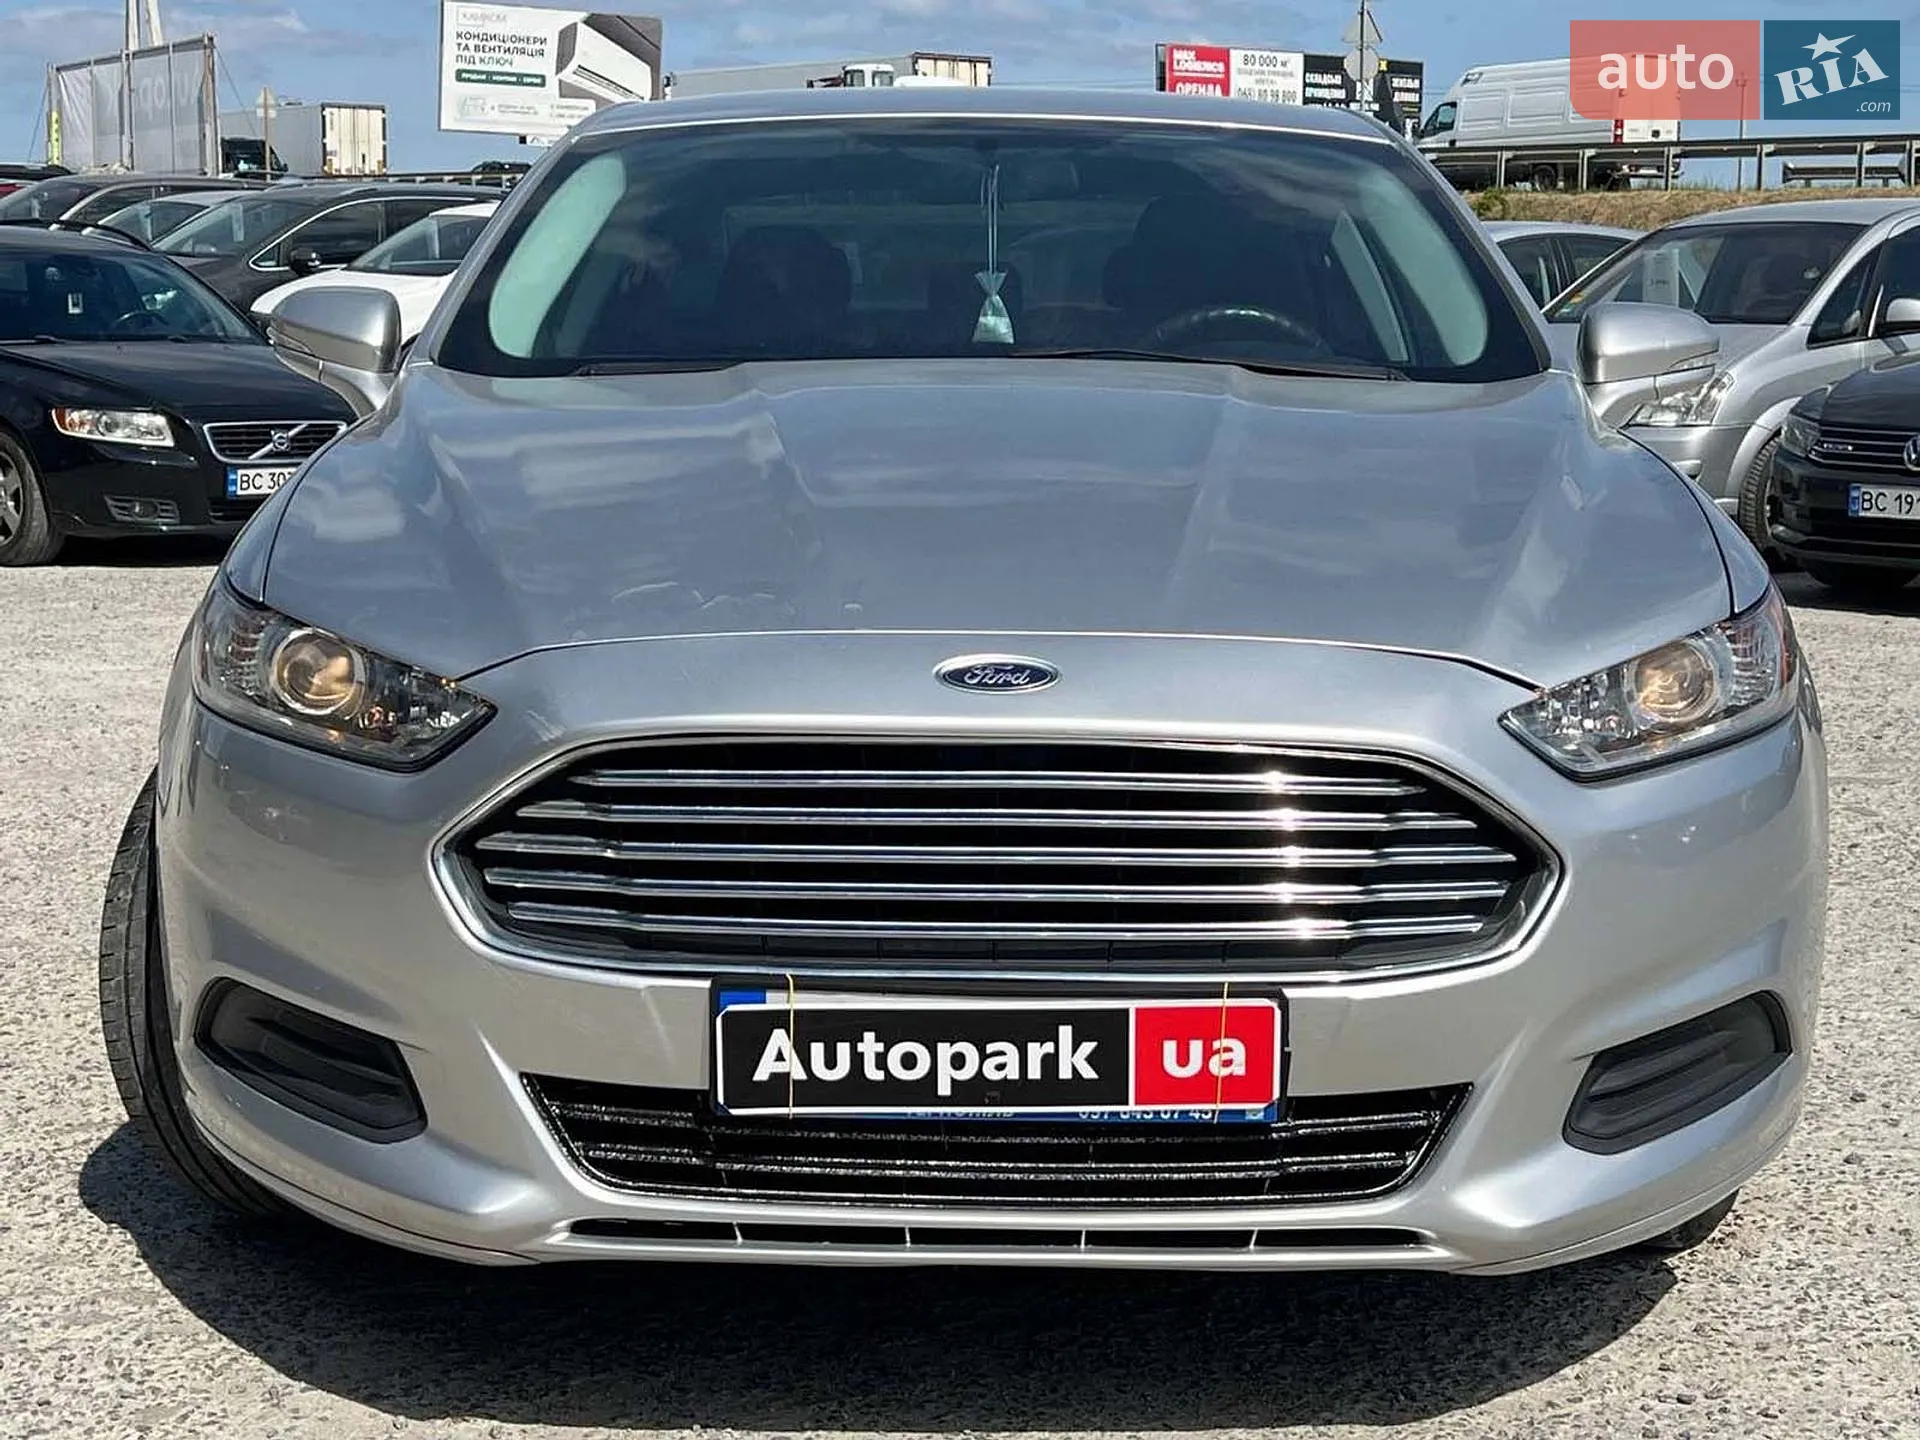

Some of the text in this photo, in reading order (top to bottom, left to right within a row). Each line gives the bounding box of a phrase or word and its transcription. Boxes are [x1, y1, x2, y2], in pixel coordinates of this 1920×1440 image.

[455, 30, 547, 45] КОНДИЦІОНЕРИ
[455, 42, 545, 58] ТА ВЕНТИЛЯЦІЯ
[455, 54, 514, 68] ПІД КЛЮЧ
[1243, 53, 1257, 67] 80
[1258, 54, 1278, 68] 000
[240, 471, 292, 491] BC 30
[1862, 491, 1888, 512] BC
[963, 663, 1031, 685] Ford
[752, 1023, 1248, 1097] Autopark ua
